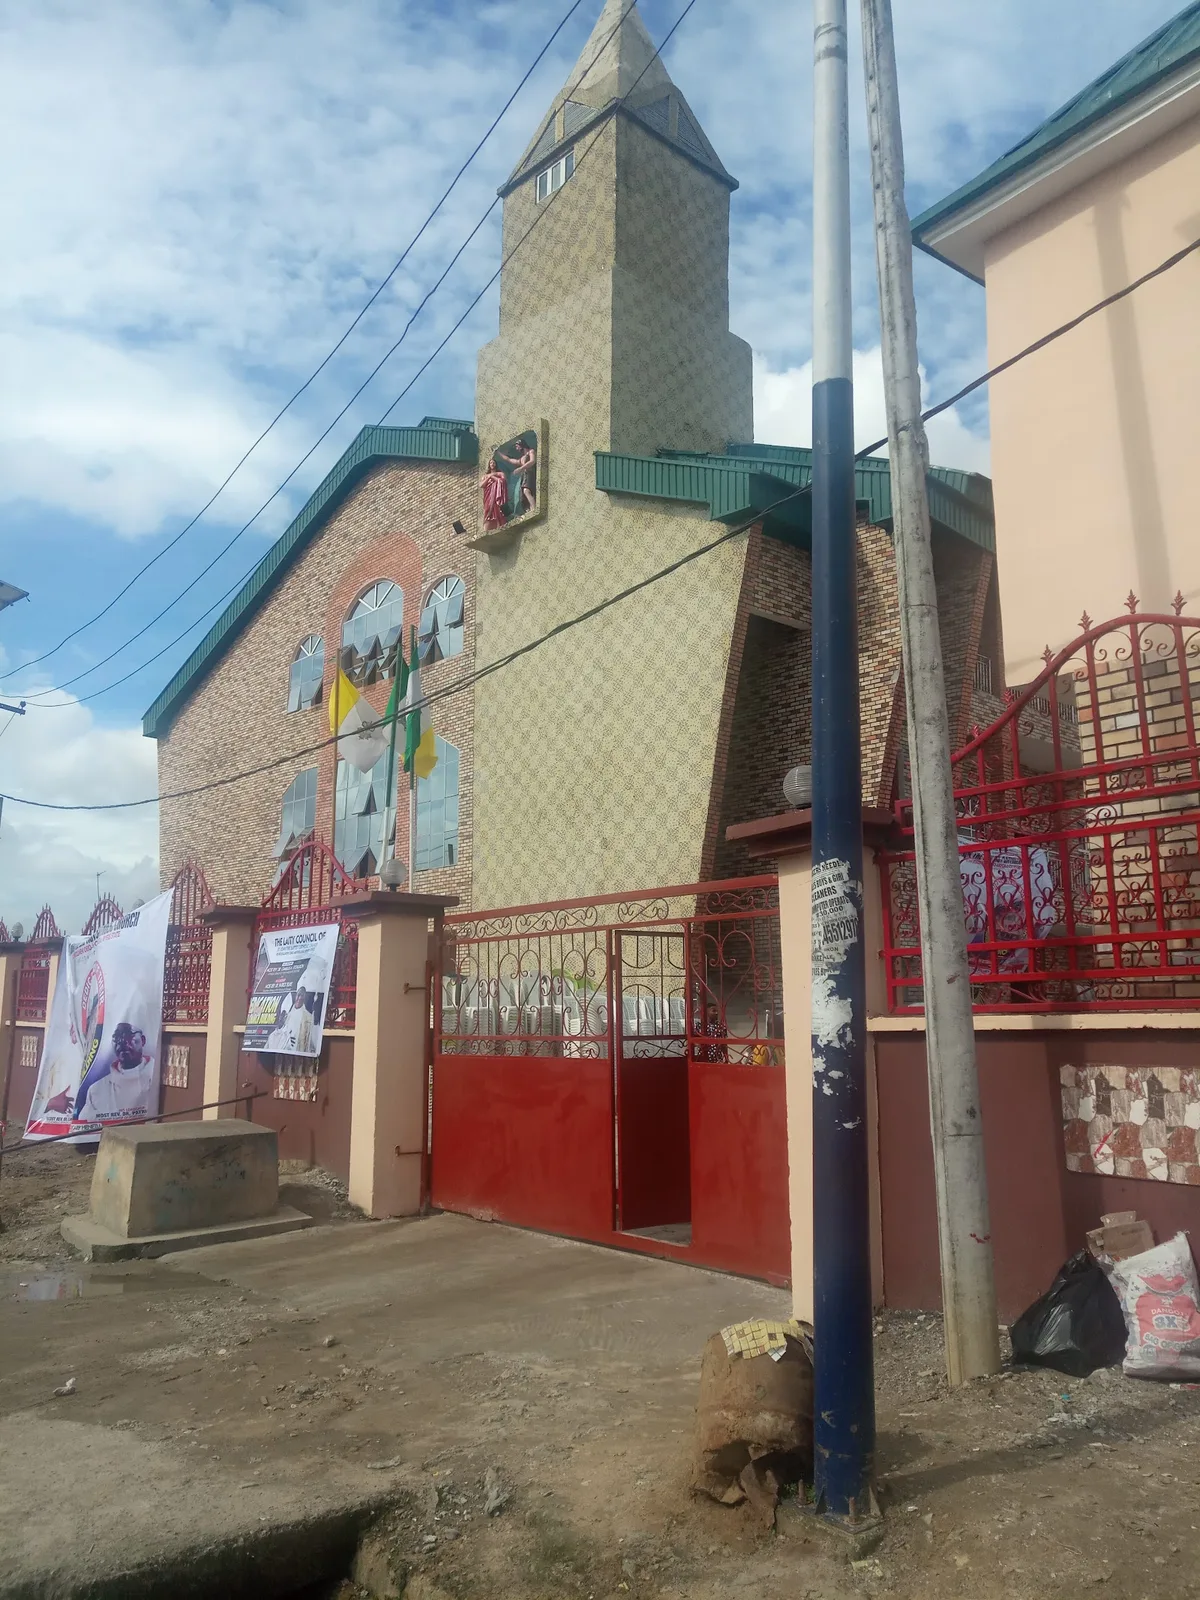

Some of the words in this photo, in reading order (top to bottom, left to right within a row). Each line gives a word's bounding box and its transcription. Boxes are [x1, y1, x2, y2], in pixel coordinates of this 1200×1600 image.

[274, 938, 283, 947] THE
[296, 933, 317, 944] COUNCIL
[318, 932, 327, 941] OF
